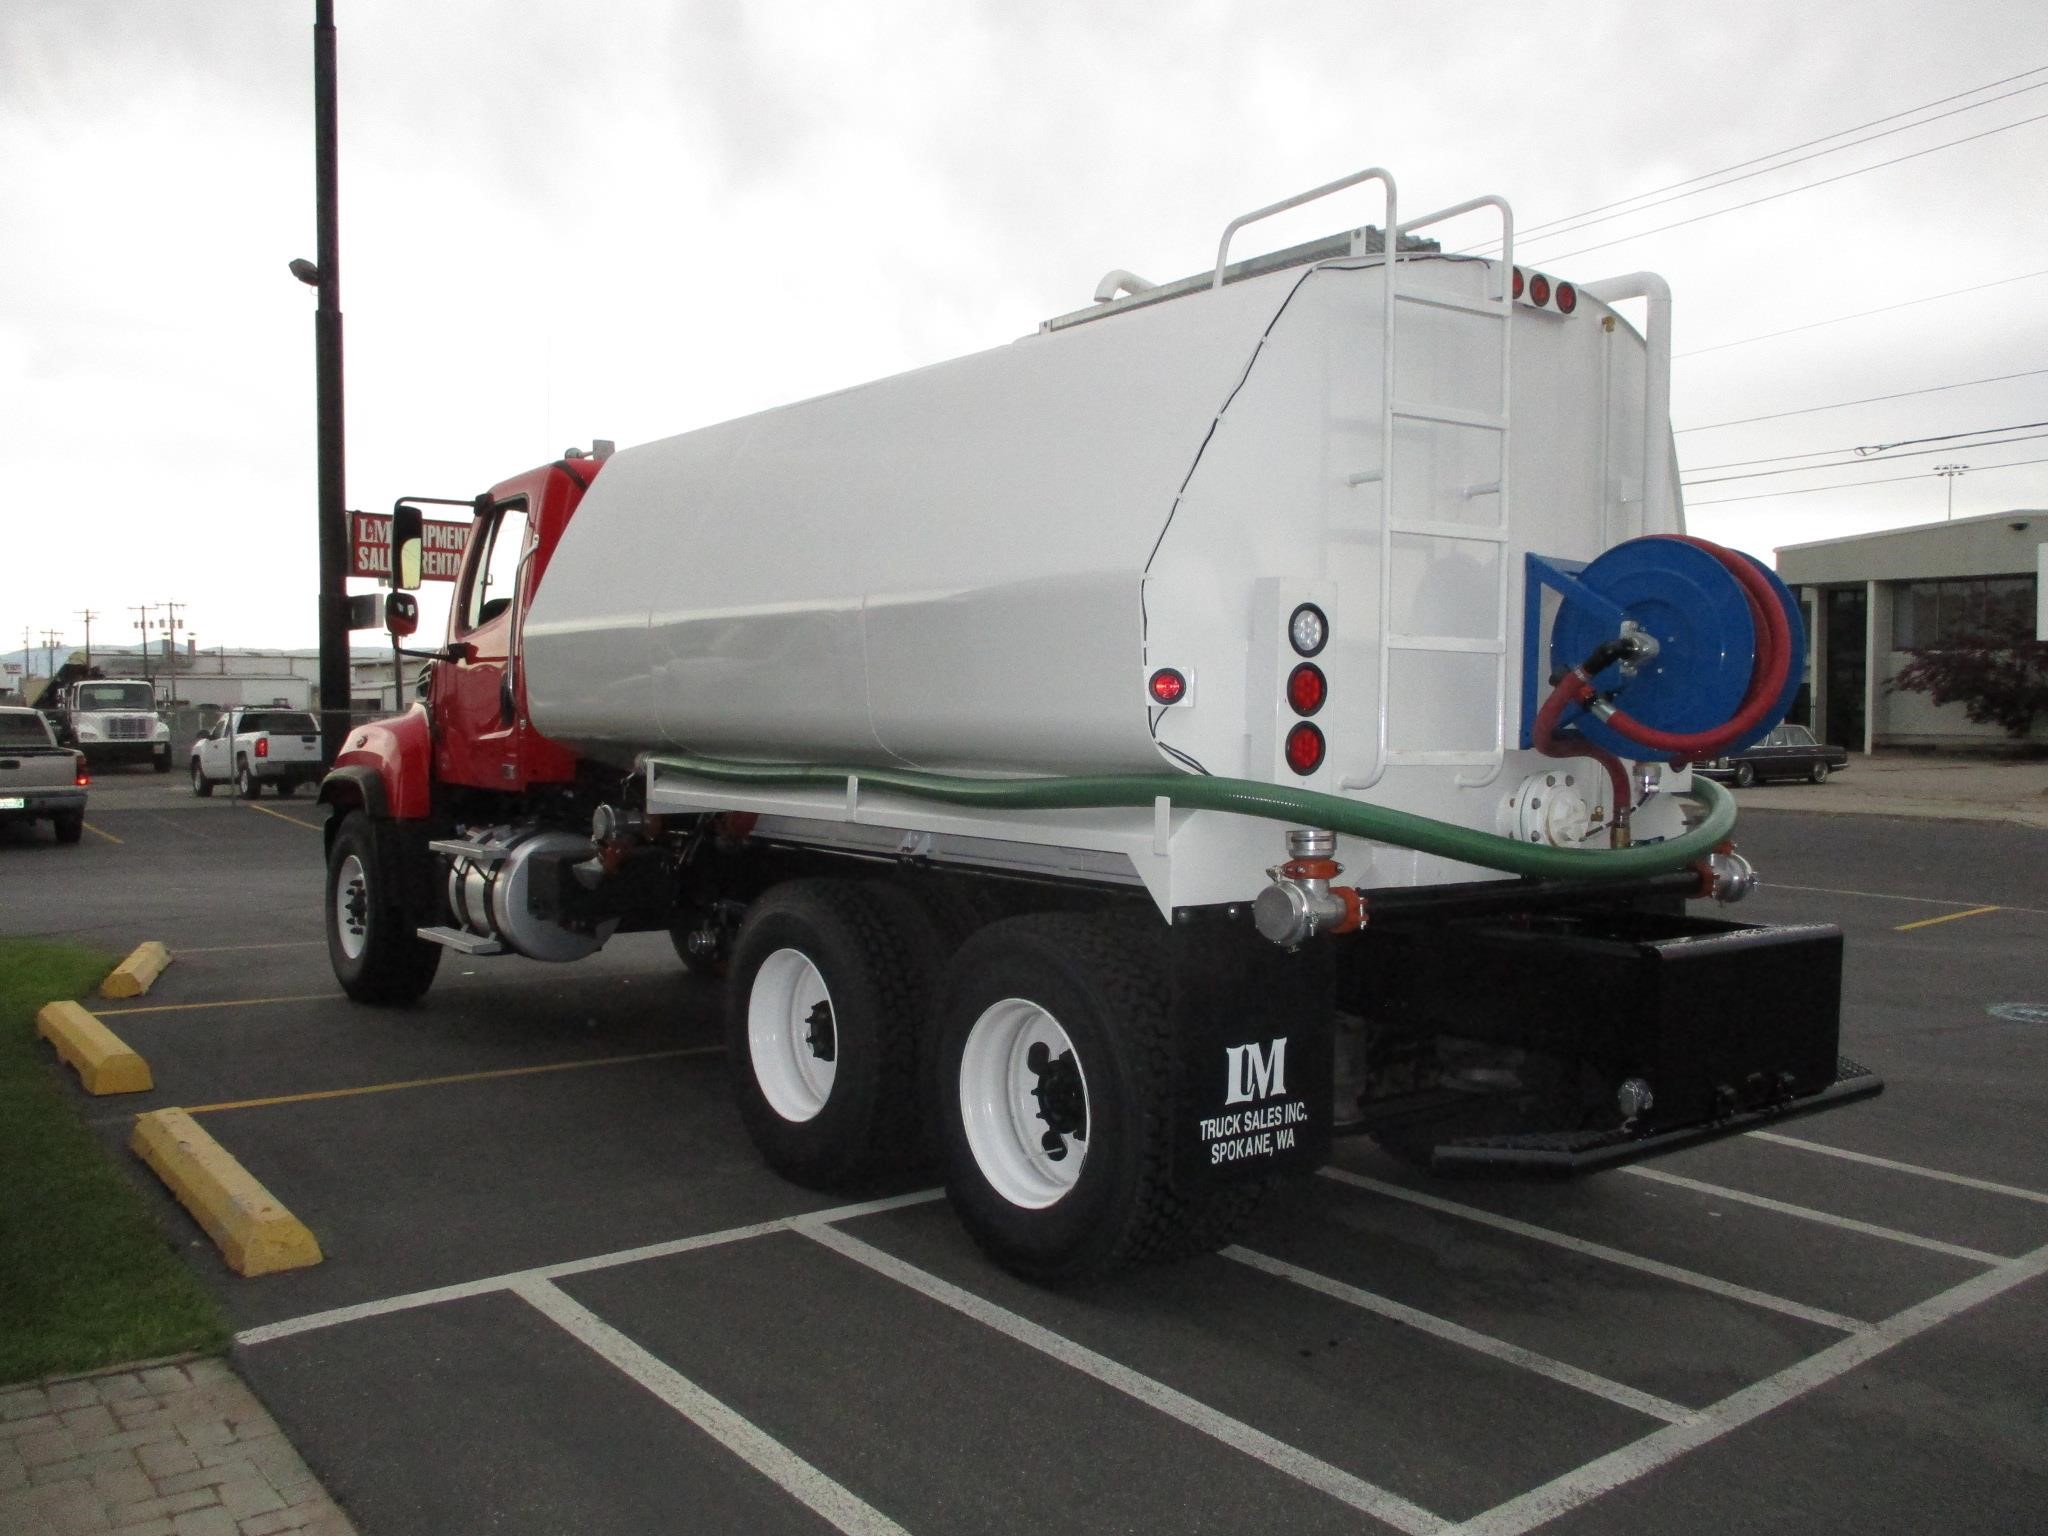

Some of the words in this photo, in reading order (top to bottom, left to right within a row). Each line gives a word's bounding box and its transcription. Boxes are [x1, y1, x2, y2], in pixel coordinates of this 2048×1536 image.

[422, 524, 470, 549] IPMENT
[358, 545, 393, 572] SAL
[422, 550, 461, 577] RENTA
[1200, 1113, 1241, 1141] TRUCK
[1243, 1105, 1282, 1132] SALES
[1284, 1101, 1308, 1124] INC.
[1211, 1133, 1274, 1165] SPOKANE,
[1276, 1128, 1295, 1150] WA
